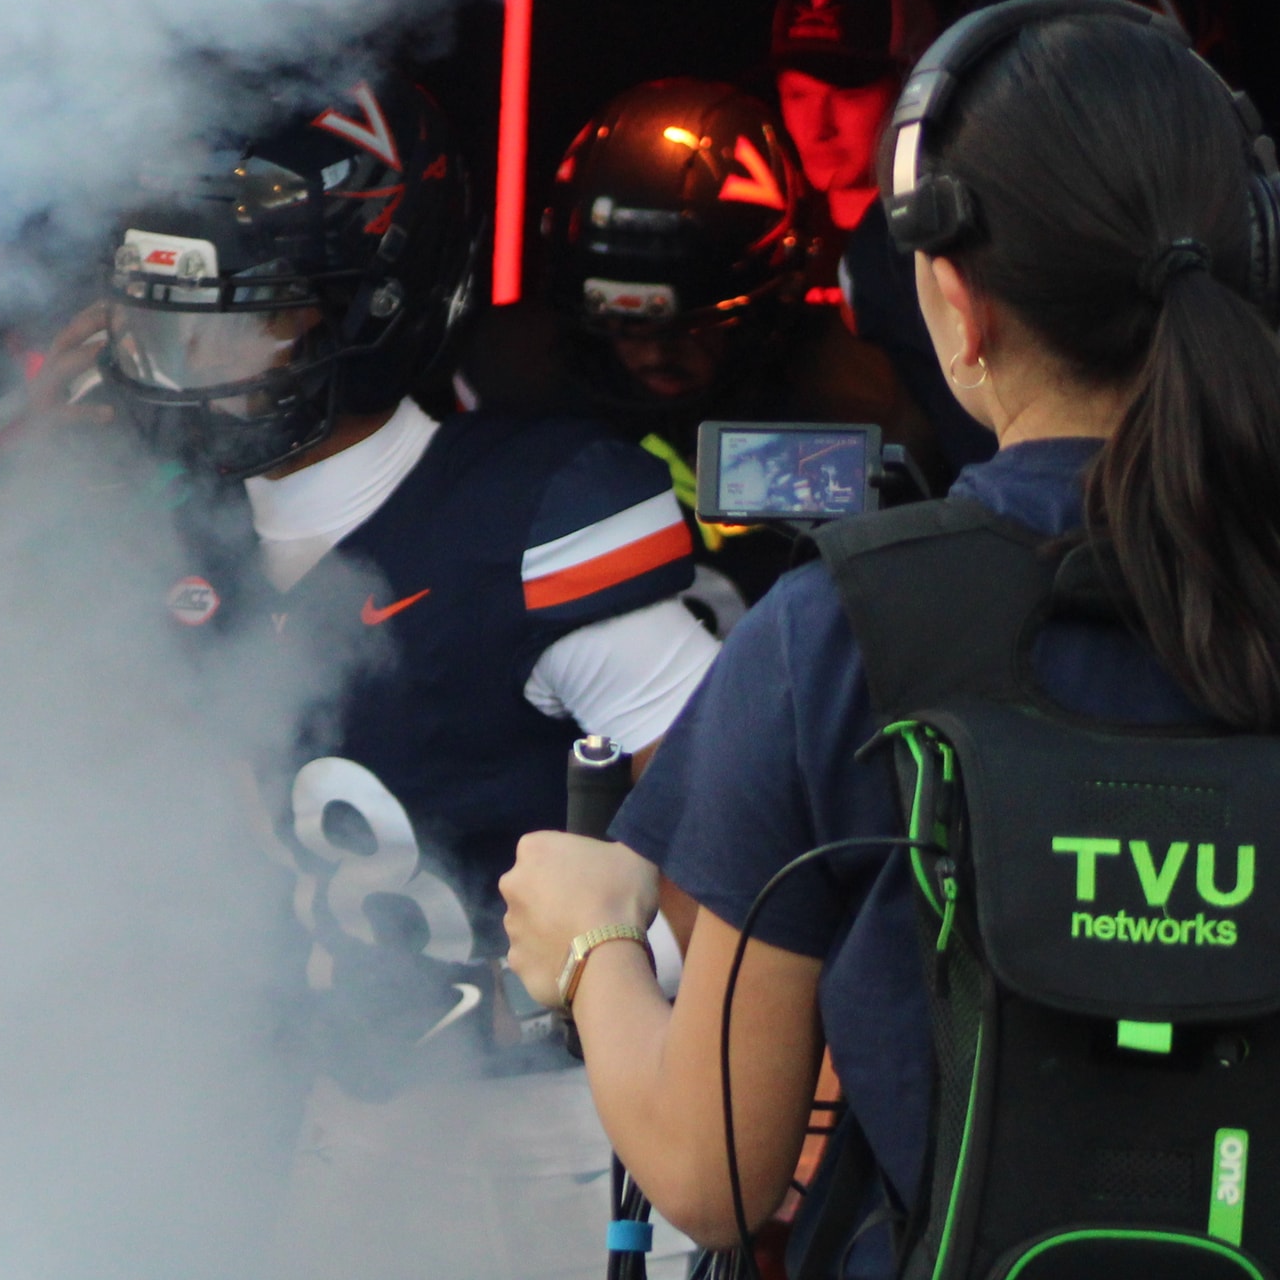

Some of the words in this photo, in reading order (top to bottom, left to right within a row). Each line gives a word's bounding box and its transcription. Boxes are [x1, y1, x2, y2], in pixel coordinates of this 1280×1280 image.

[311, 81, 403, 173] V
[1051, 836, 1256, 908] TVU
[1071, 910, 1238, 947] networks
[1216, 1135, 1245, 1206] one
